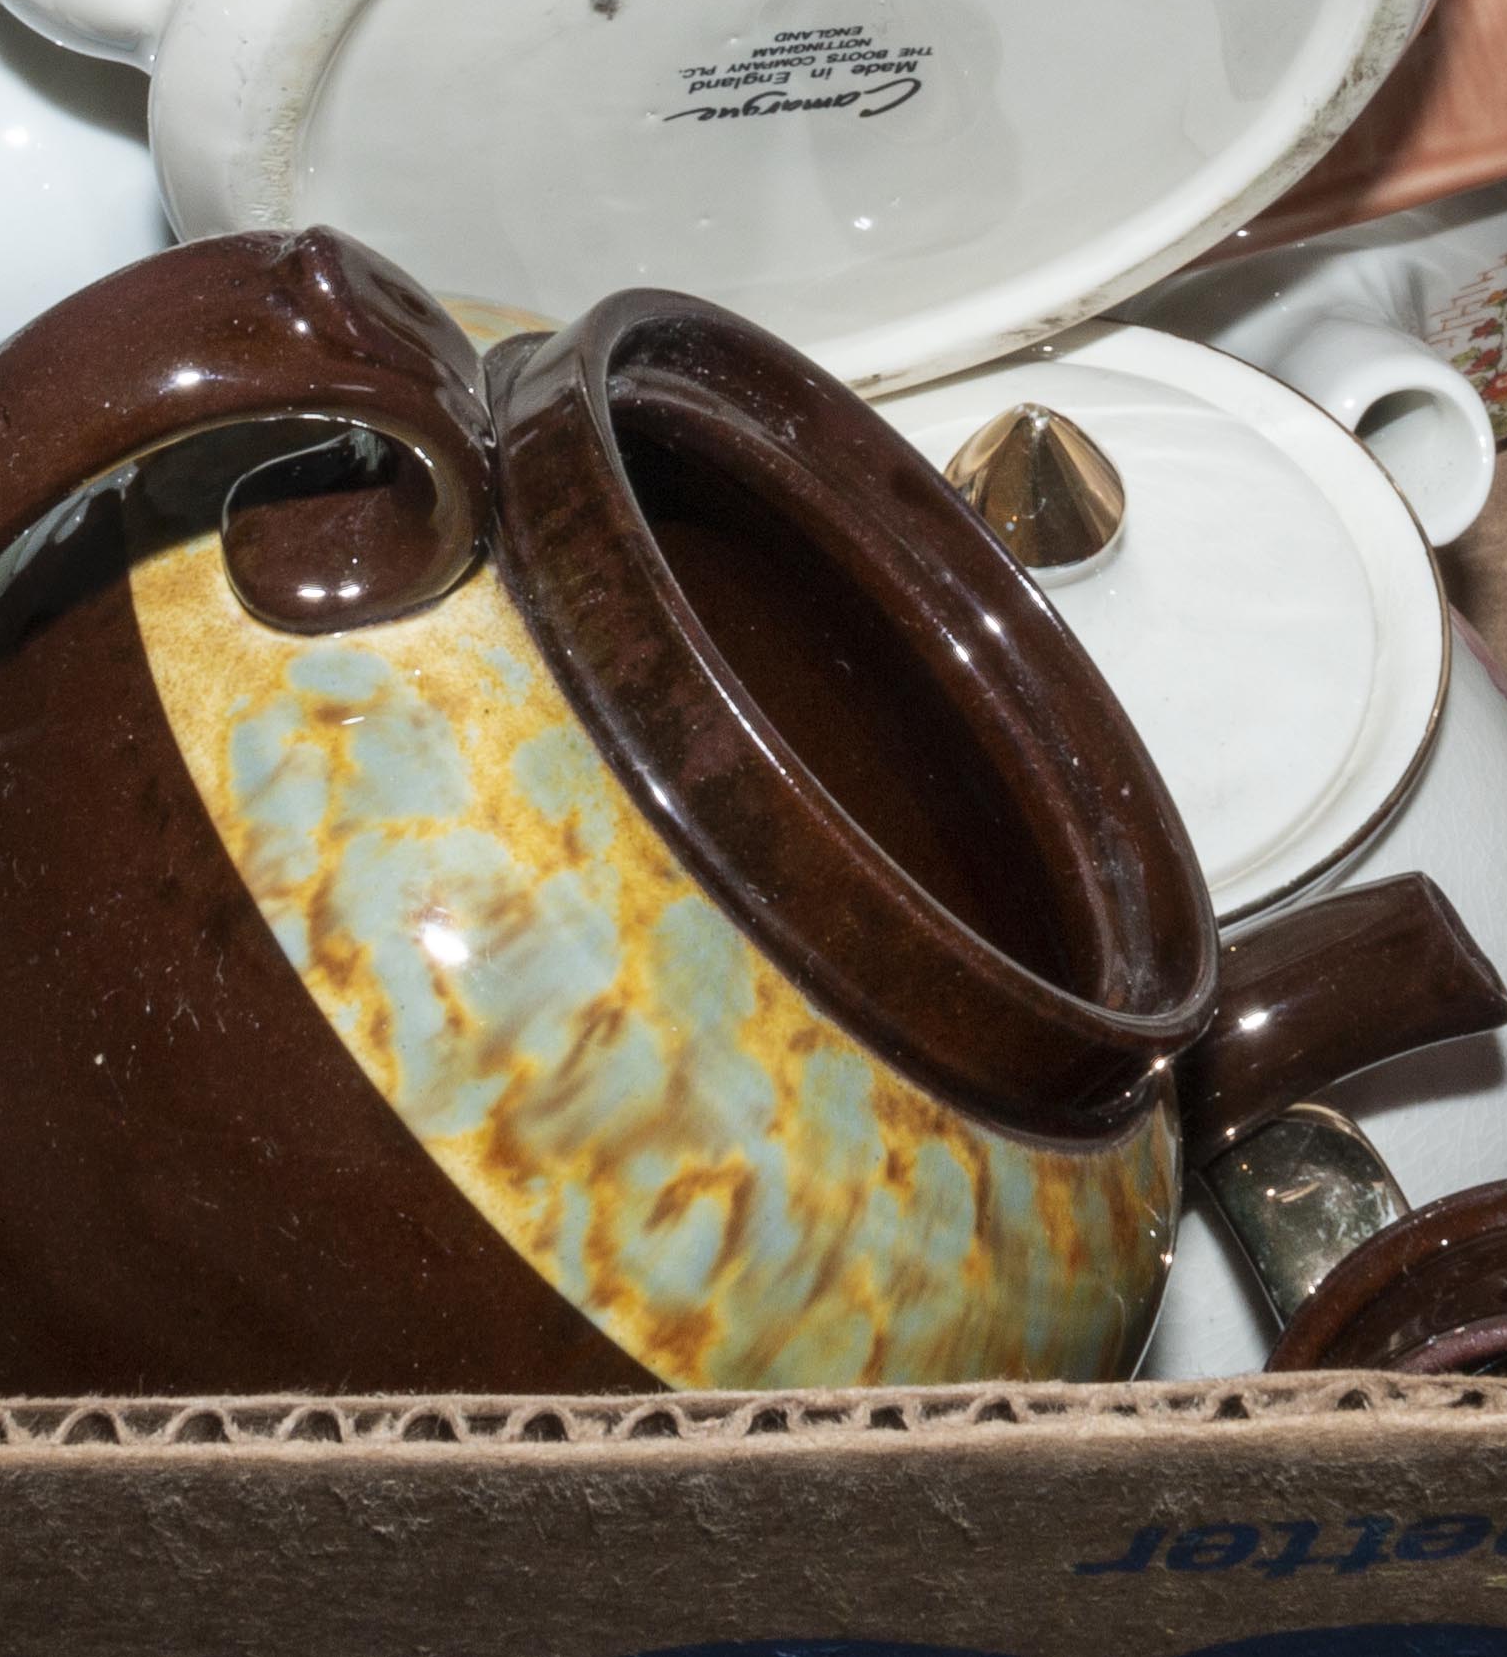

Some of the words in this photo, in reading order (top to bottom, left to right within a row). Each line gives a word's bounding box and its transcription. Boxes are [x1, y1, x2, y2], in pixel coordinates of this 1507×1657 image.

[773, 25, 864, 43] ENGLAND
[751, 37, 873, 59] NOTTINGHAM
[827, 49, 889, 65] BOOTS
[898, 46, 934, 59] THE
[726, 56, 816, 74] COMPANY
[810, 67, 834, 81] in
[850, 60, 919, 77] Made
[689, 69, 792, 94] England
[662, 77, 923, 123] Camargue
